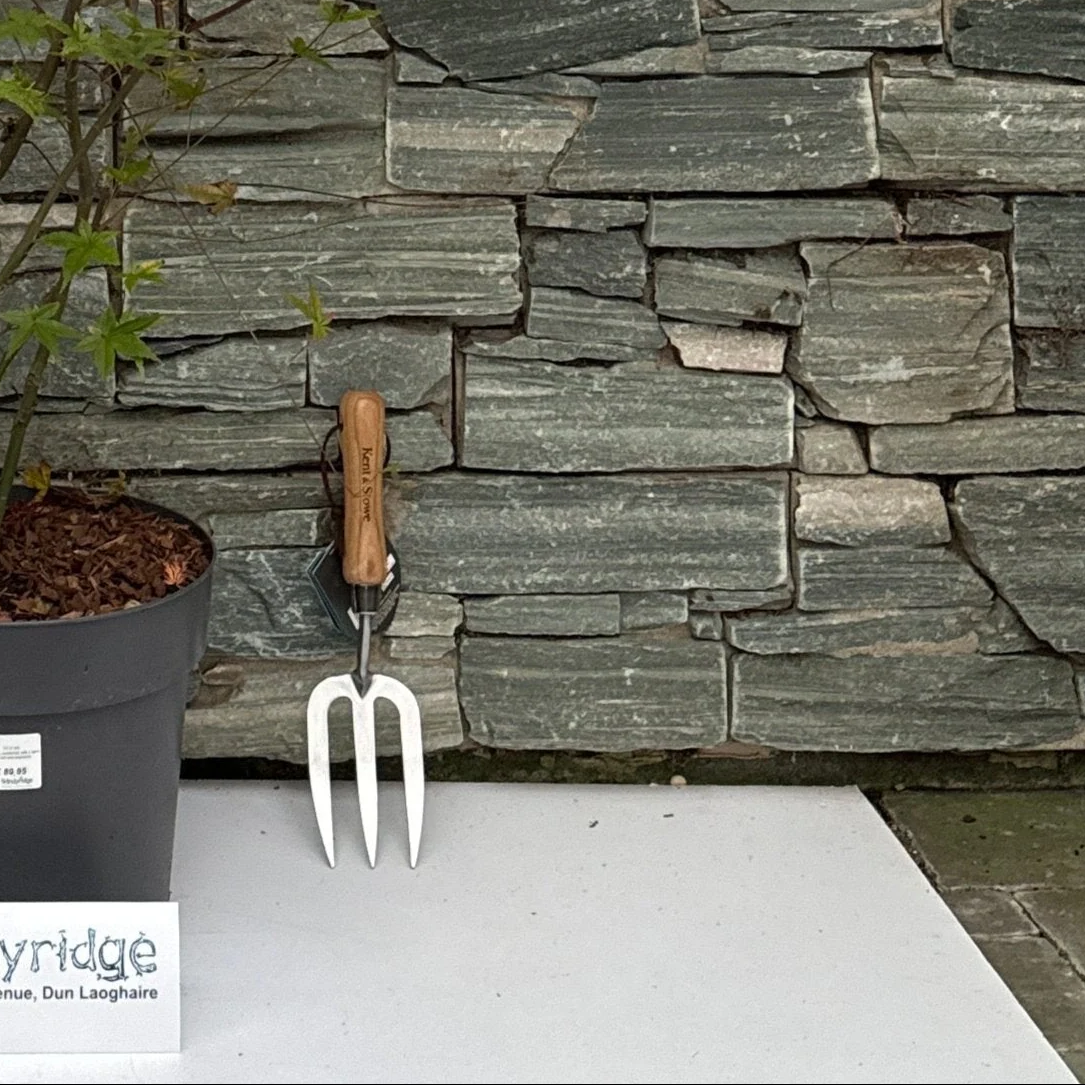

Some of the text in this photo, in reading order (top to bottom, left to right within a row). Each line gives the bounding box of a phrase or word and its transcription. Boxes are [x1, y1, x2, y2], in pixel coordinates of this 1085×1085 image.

[362, 447, 373, 475] Kent
[42, 986, 74, 1000] Dun
[79, 986, 158, 1003] Laoghaire
